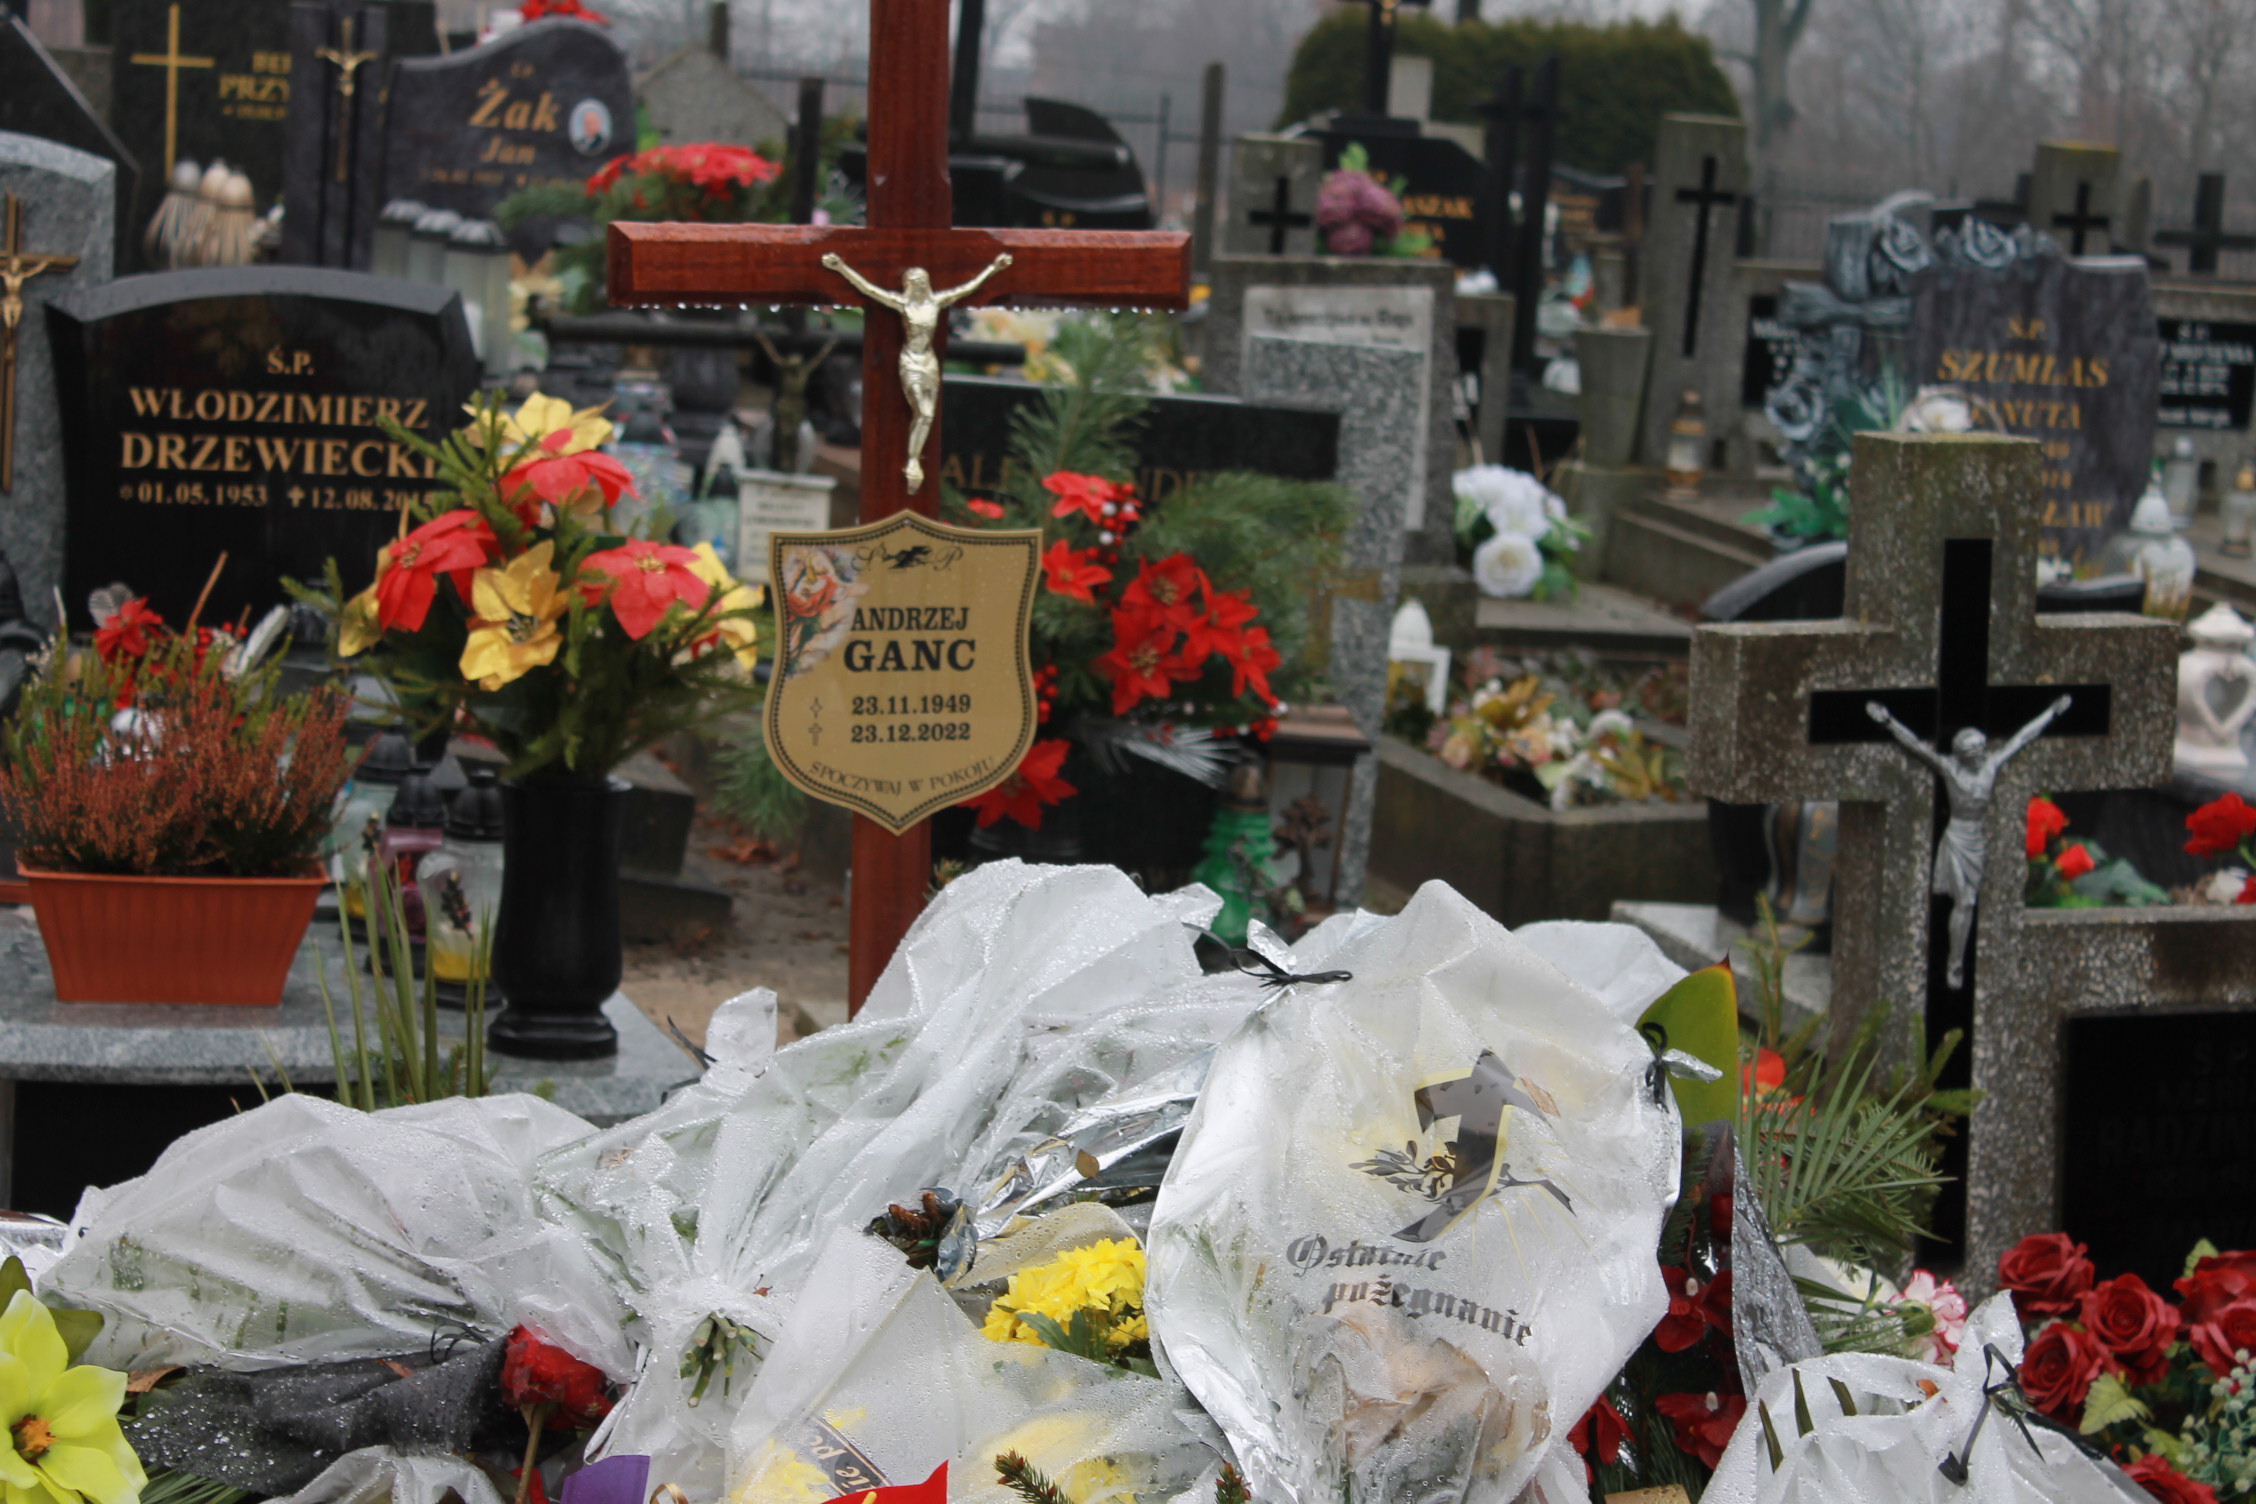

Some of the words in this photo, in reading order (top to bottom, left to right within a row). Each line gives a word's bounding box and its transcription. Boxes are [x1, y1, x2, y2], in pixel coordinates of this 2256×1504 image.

[469, 78, 560, 132] Żak
[480, 136, 537, 165] Jan
[267, 345, 315, 375] Ś.P.
[129, 386, 430, 429] WŁODZIMIERZ
[121, 432, 440, 479] DRZEWIECKI
[851, 607, 970, 632] ANDRZEJ
[844, 639, 976, 673] GANC
[851, 694, 972, 716] 23.11.1949
[851, 722, 972, 744] 23.12.2022
[809, 760, 902, 797] SPOCZYWAJ
[908, 779, 924, 793] W
[930, 756, 995, 790] POKOJU
[1286, 1233, 1447, 1277] Ostatnie
[1320, 1273, 1533, 1347] pożegnanie
